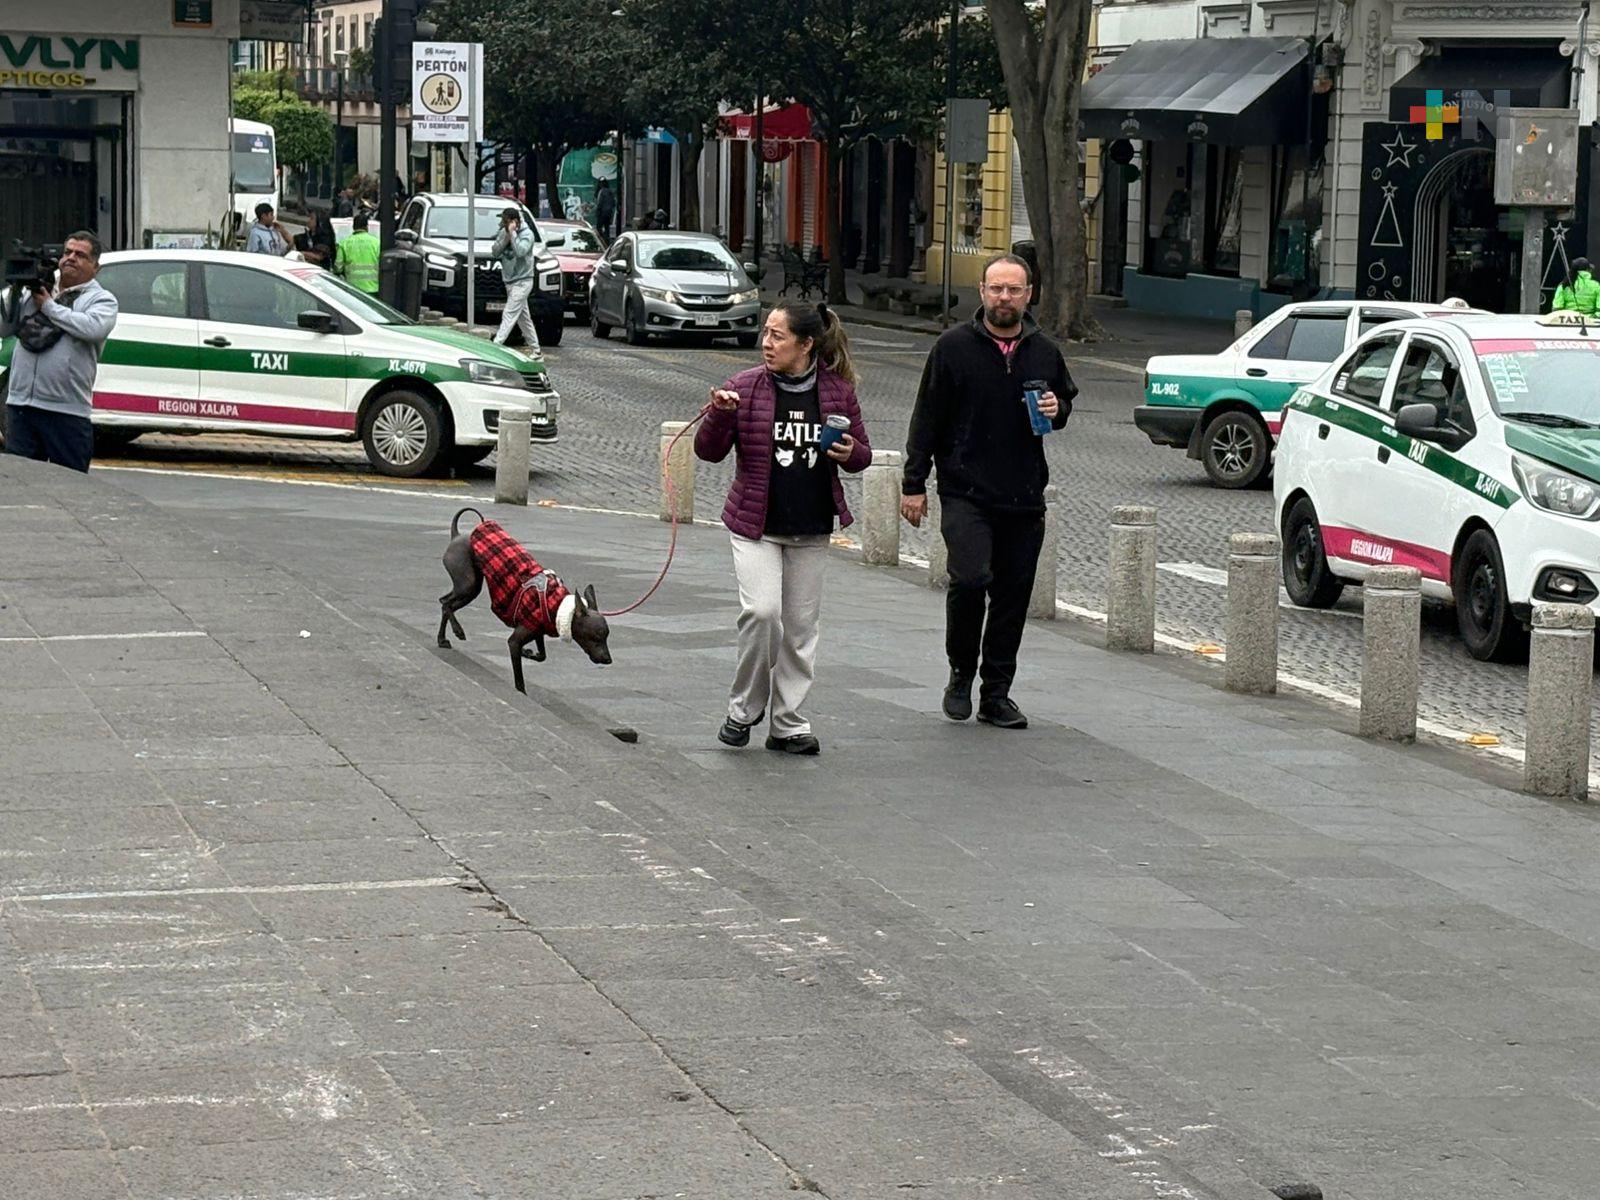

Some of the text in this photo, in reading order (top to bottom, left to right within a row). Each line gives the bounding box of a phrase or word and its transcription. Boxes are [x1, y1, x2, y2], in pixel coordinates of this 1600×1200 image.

[416, 57, 467, 72] PEATÓN
[1559, 315, 1584, 324] TAXI
[251, 352, 289, 371] TAXI
[1151, 382, 1180, 396] XL-902
[158, 399, 239, 417] REGION XALAPA
[788, 410, 805, 420] THE
[774, 422, 821, 447] EATLE
[1408, 438, 1429, 464] TAXI
